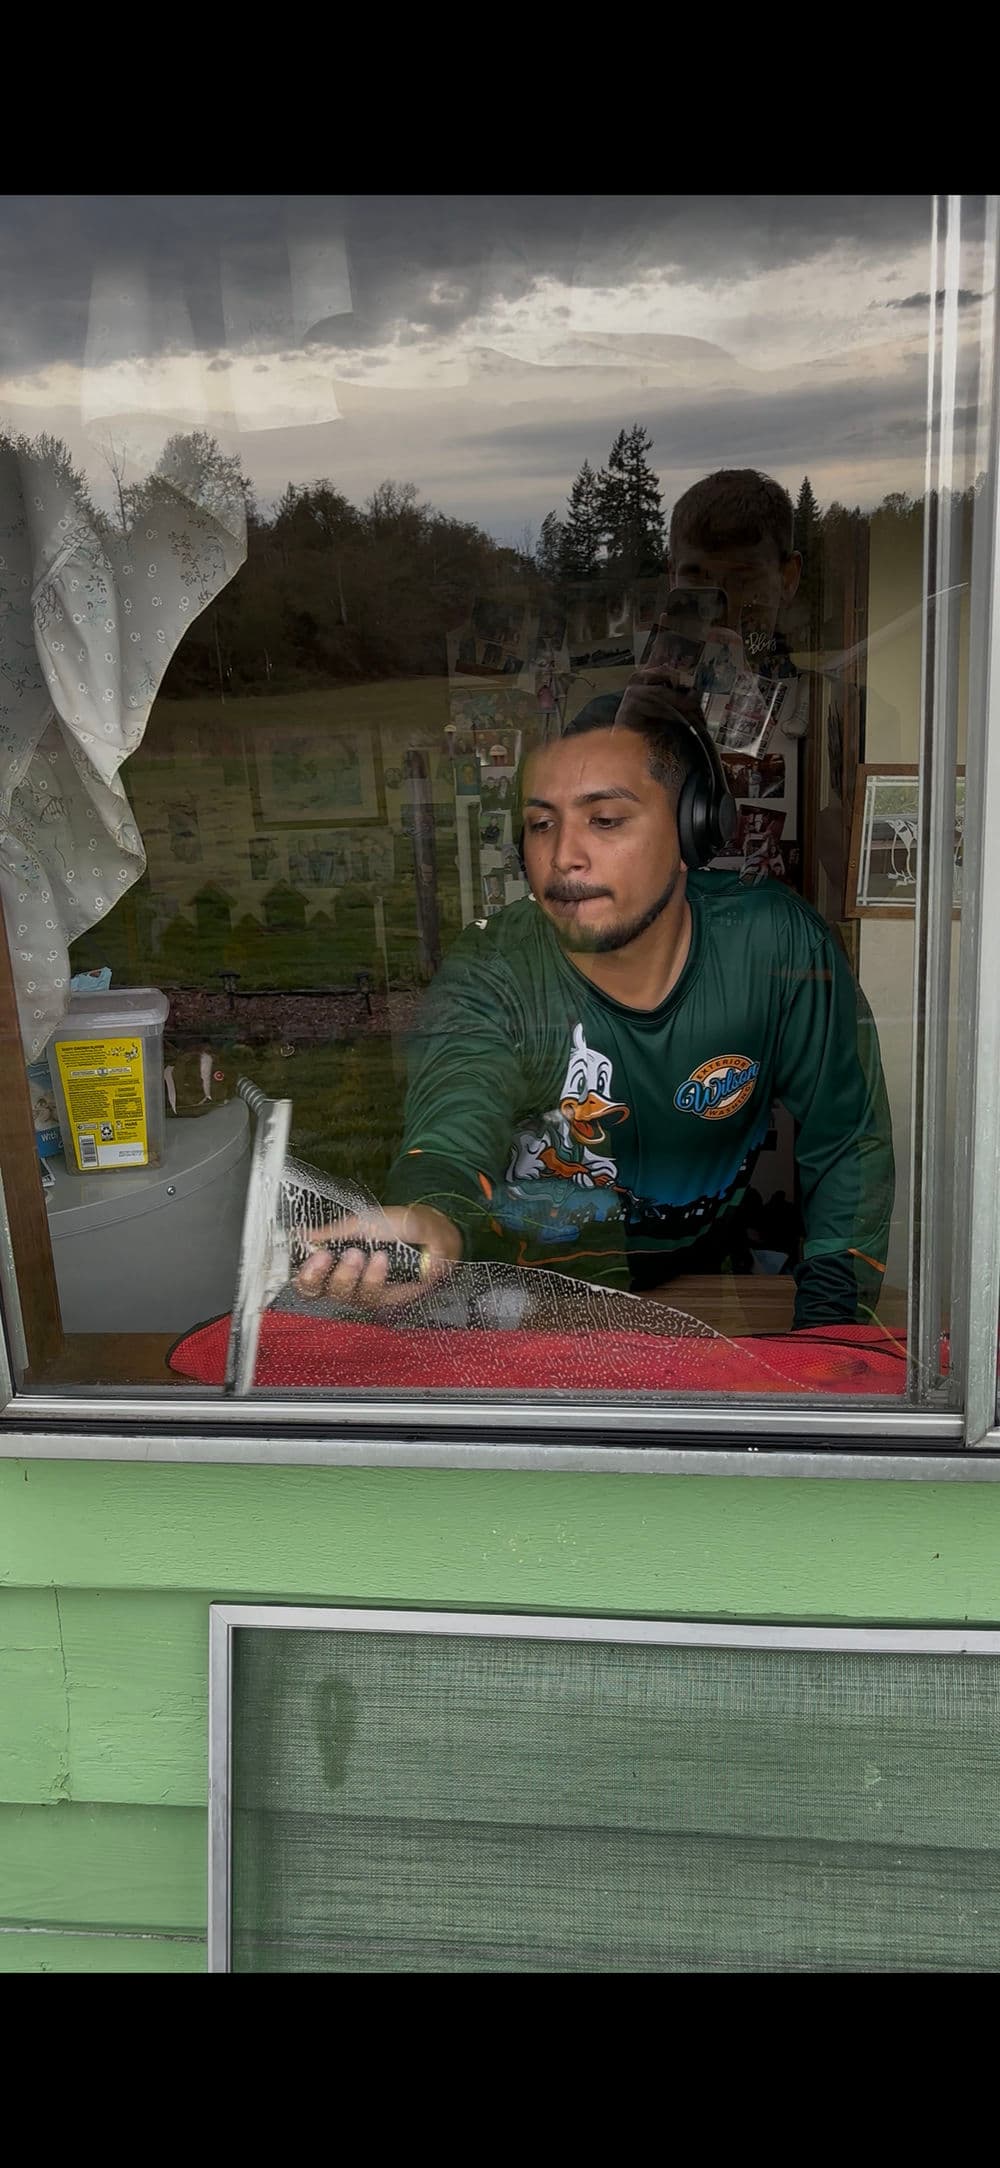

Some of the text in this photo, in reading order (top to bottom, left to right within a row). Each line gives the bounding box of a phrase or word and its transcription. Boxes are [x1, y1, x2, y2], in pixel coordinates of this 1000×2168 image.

[697, 1058, 747, 1080] EXTERIOR
[676, 1062, 759, 1113] Wilson
[708, 1085, 752, 1116] WASHING
